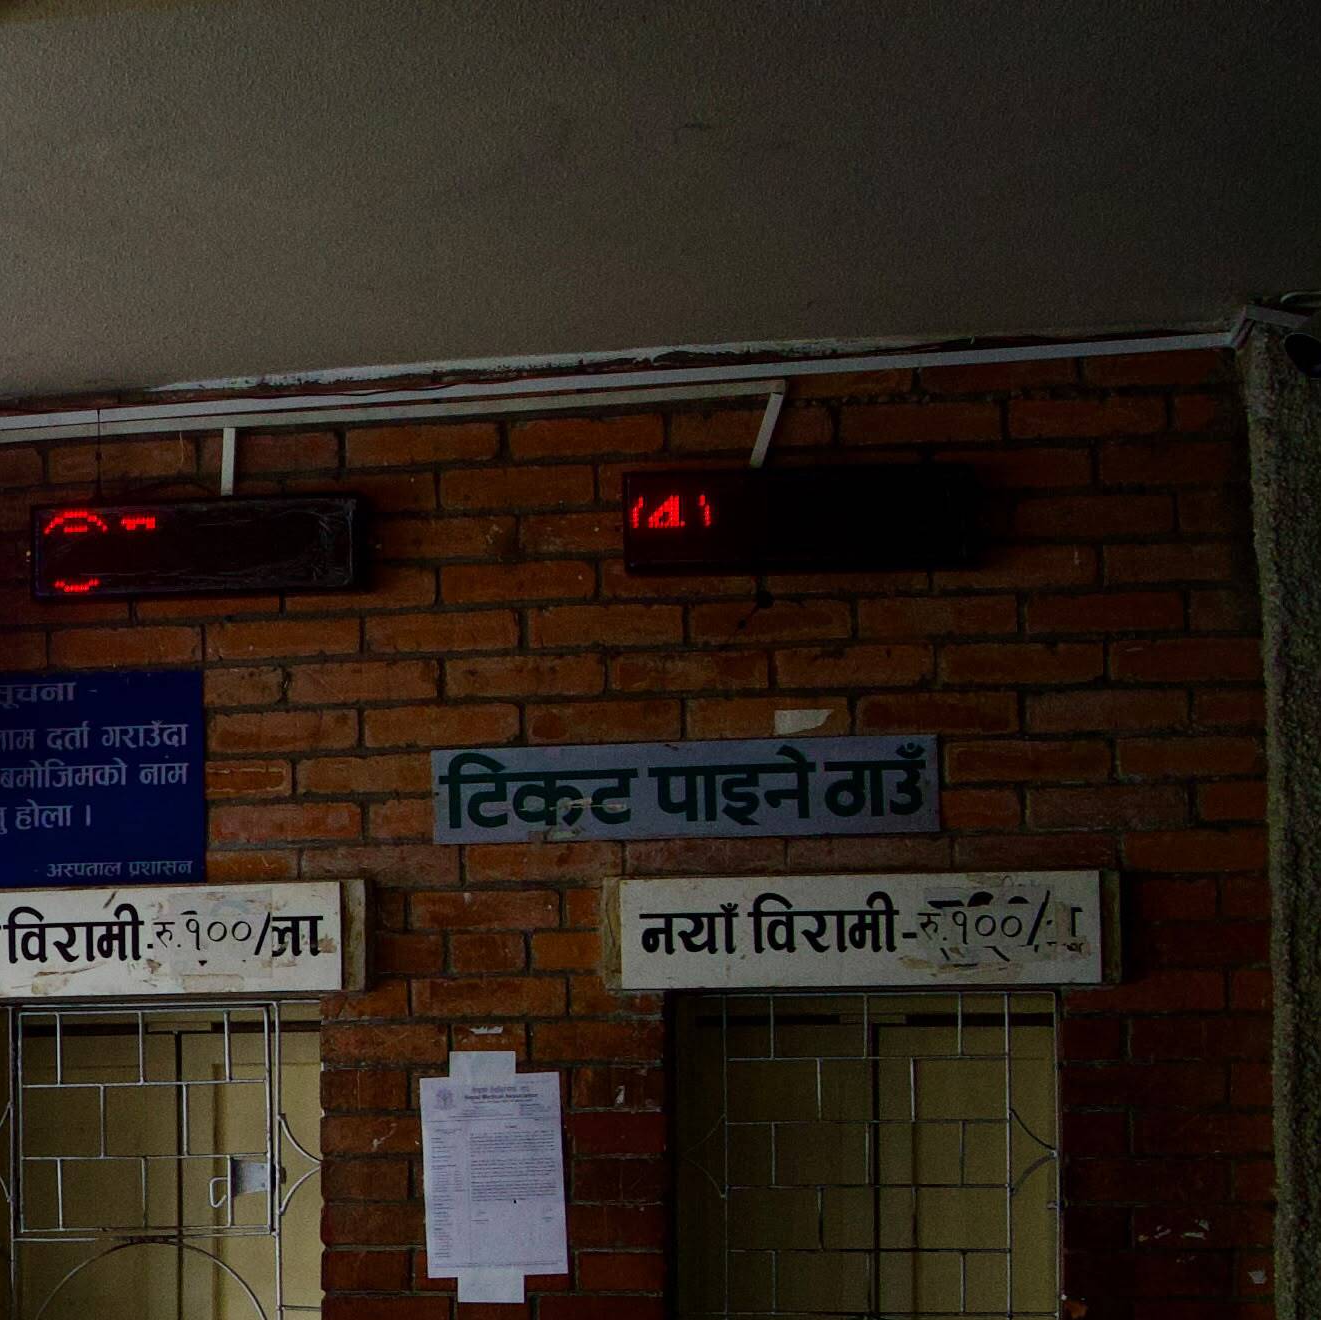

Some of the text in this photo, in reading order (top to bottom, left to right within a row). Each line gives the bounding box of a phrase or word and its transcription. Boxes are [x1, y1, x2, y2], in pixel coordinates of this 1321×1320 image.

[46, 720, 91, 751] दर्ता
[101, 720, 190, 749] गराउँदा
[0, 757, 128, 790] बमोजिमको
[439, 742, 926, 829] टिकट पाइने ठाउँ
[46, 860, 193, 877] अस्पताल प्रशासन
[639, 902, 739, 956] नयाँ
